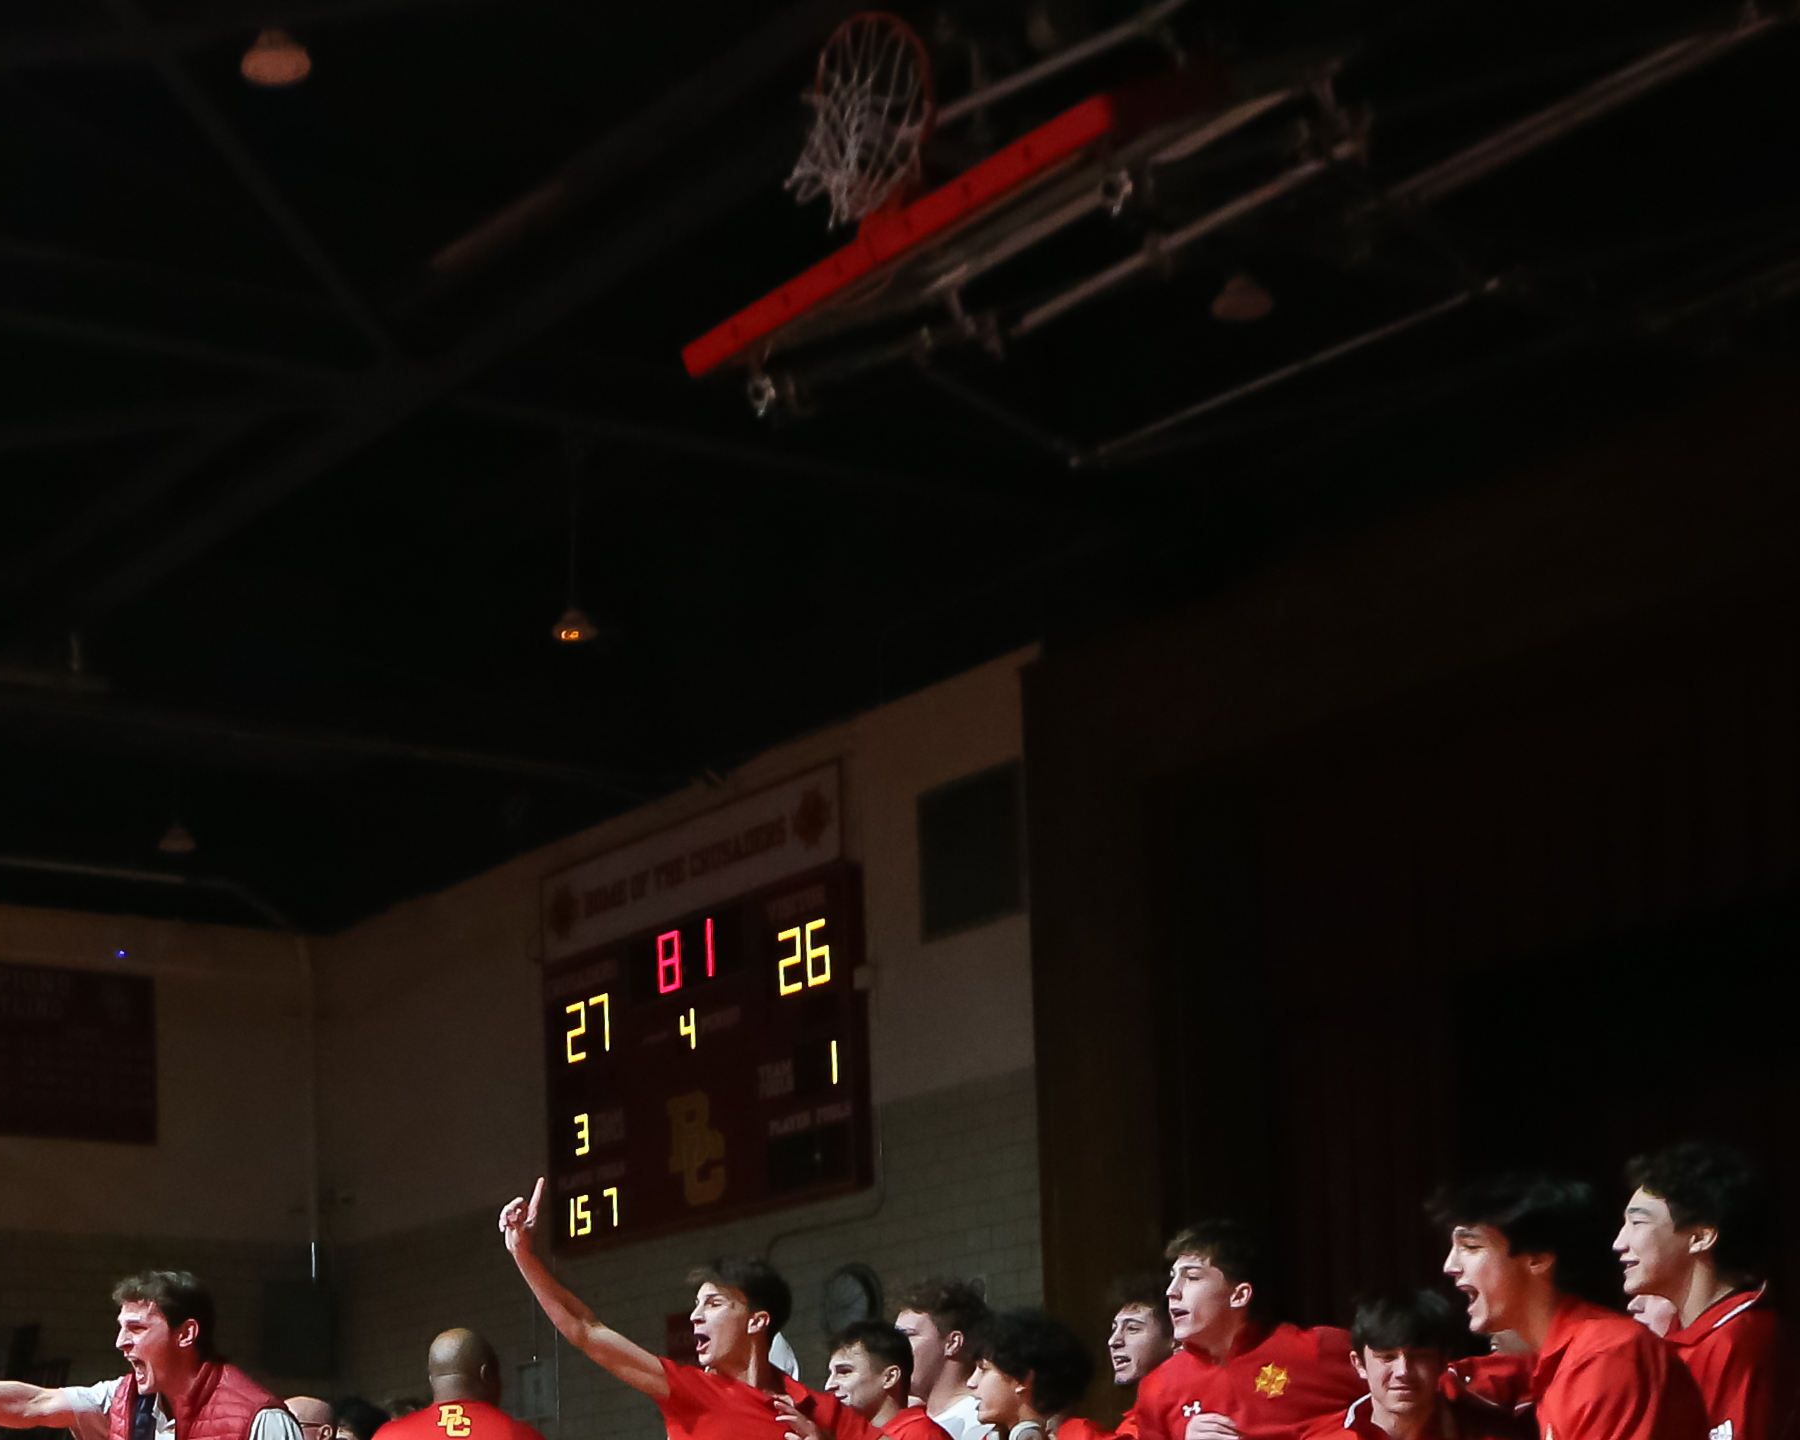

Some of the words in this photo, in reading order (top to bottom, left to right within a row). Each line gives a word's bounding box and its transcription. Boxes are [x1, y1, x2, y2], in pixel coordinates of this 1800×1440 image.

[584, 877, 627, 918] HOME
[631, 869, 650, 900] OF
[654, 856, 685, 889] THE
[689, 815, 786, 877] CRUSADERS
[777, 917, 831, 996] 26
[565, 993, 610, 1063] 27
[679, 1007, 697, 1050] 4
[757, 1058, 792, 1081] TEAM
[830, 1039, 839, 1085] 1
[573, 1113, 590, 1156] 3
[769, 1111, 811, 1137] PLAYER
[568, 1194, 592, 1238] 15
[603, 1187, 619, 1228] 7
[437, 1404, 471, 1437] BC
